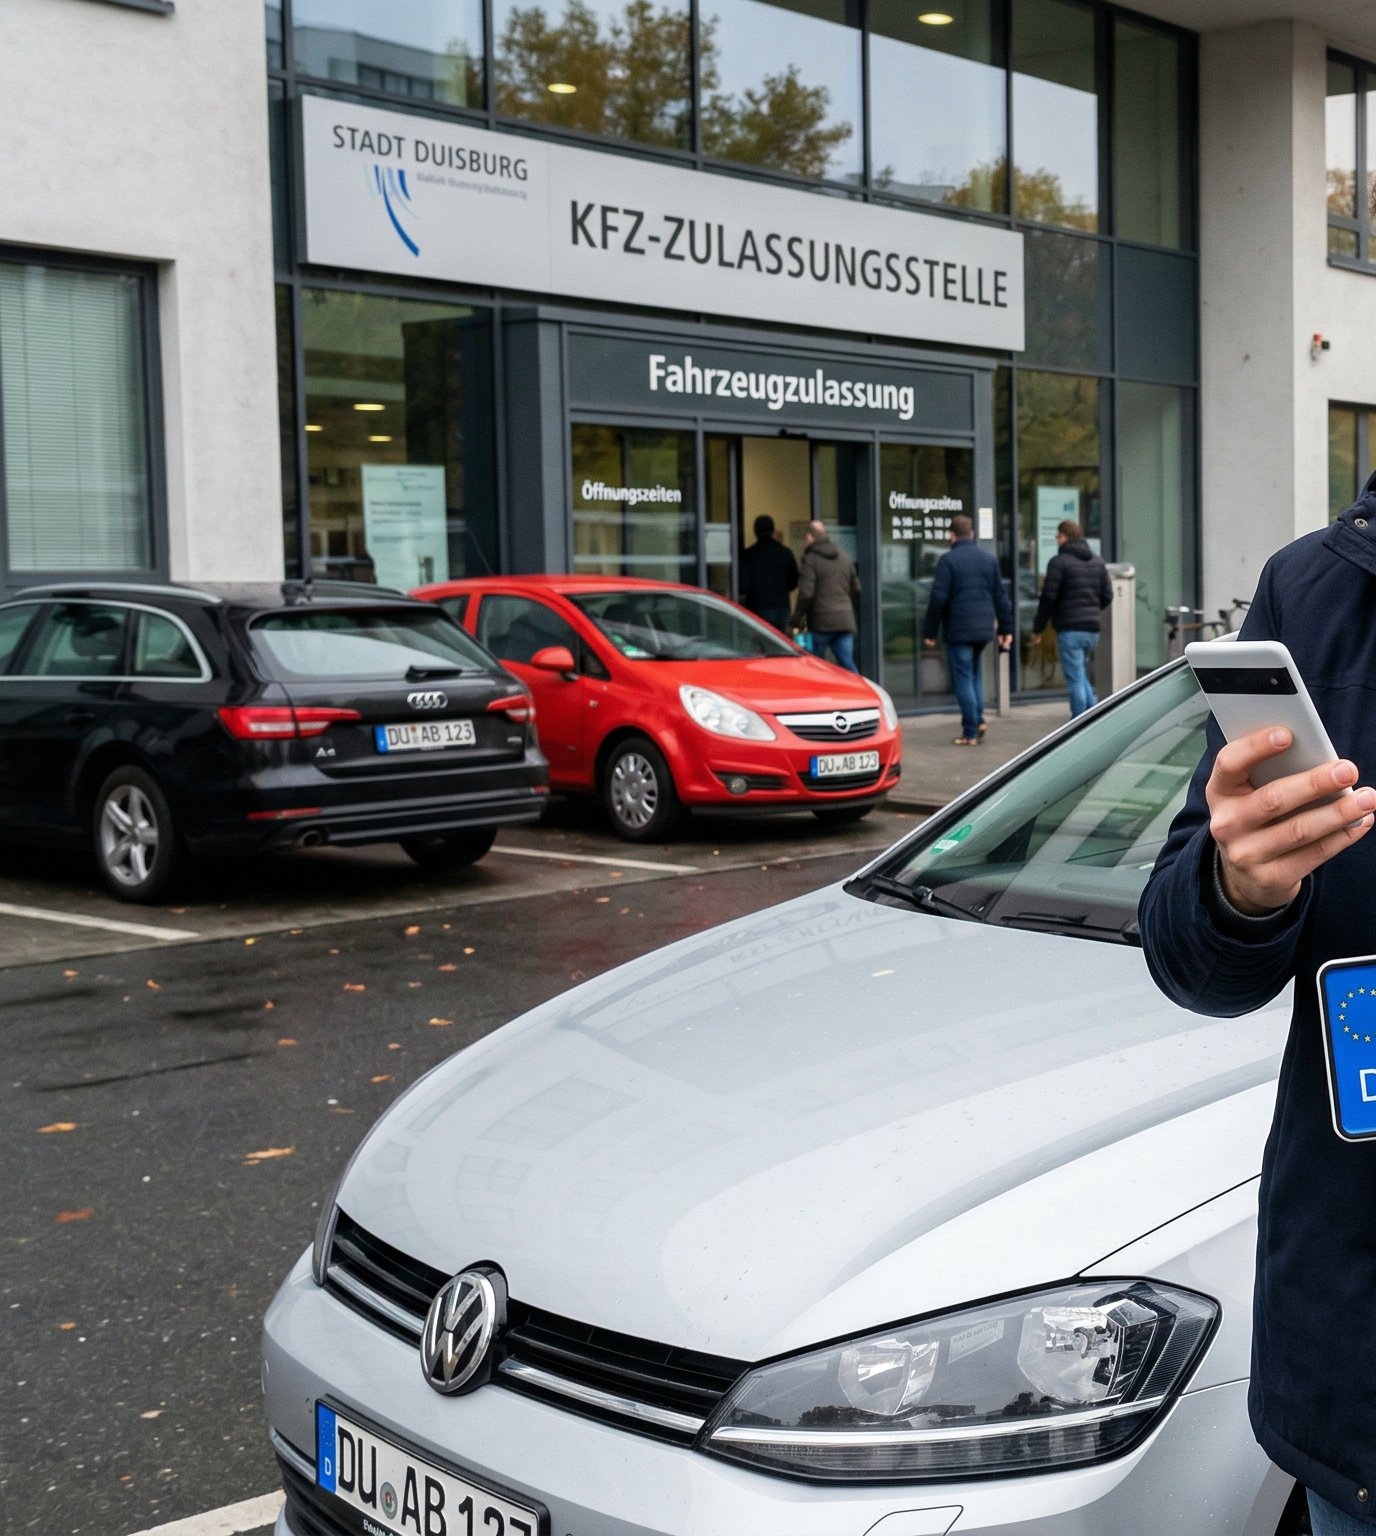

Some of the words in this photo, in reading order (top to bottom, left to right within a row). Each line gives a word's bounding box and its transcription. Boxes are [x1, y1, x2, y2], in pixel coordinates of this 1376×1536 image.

[333, 125, 405, 159] STADT
[414, 140, 528, 181] DUISBURG
[570, 200, 1008, 308] KFZ-ZULASSUNGSSTELLE
[648, 354, 915, 420] Fahrzeugzulassung
[582, 479, 682, 505] Öffnungszeiten
[388, 727, 410, 746] DU
[422, 725, 441, 742] AB
[444, 723, 472, 741] 123
[819, 758, 834, 773] DU
[842, 756, 855, 770] AB
[324, 1457, 332, 1476] D
[337, 1425, 378, 1510] DU
[401, 1465, 447, 1536] AB
